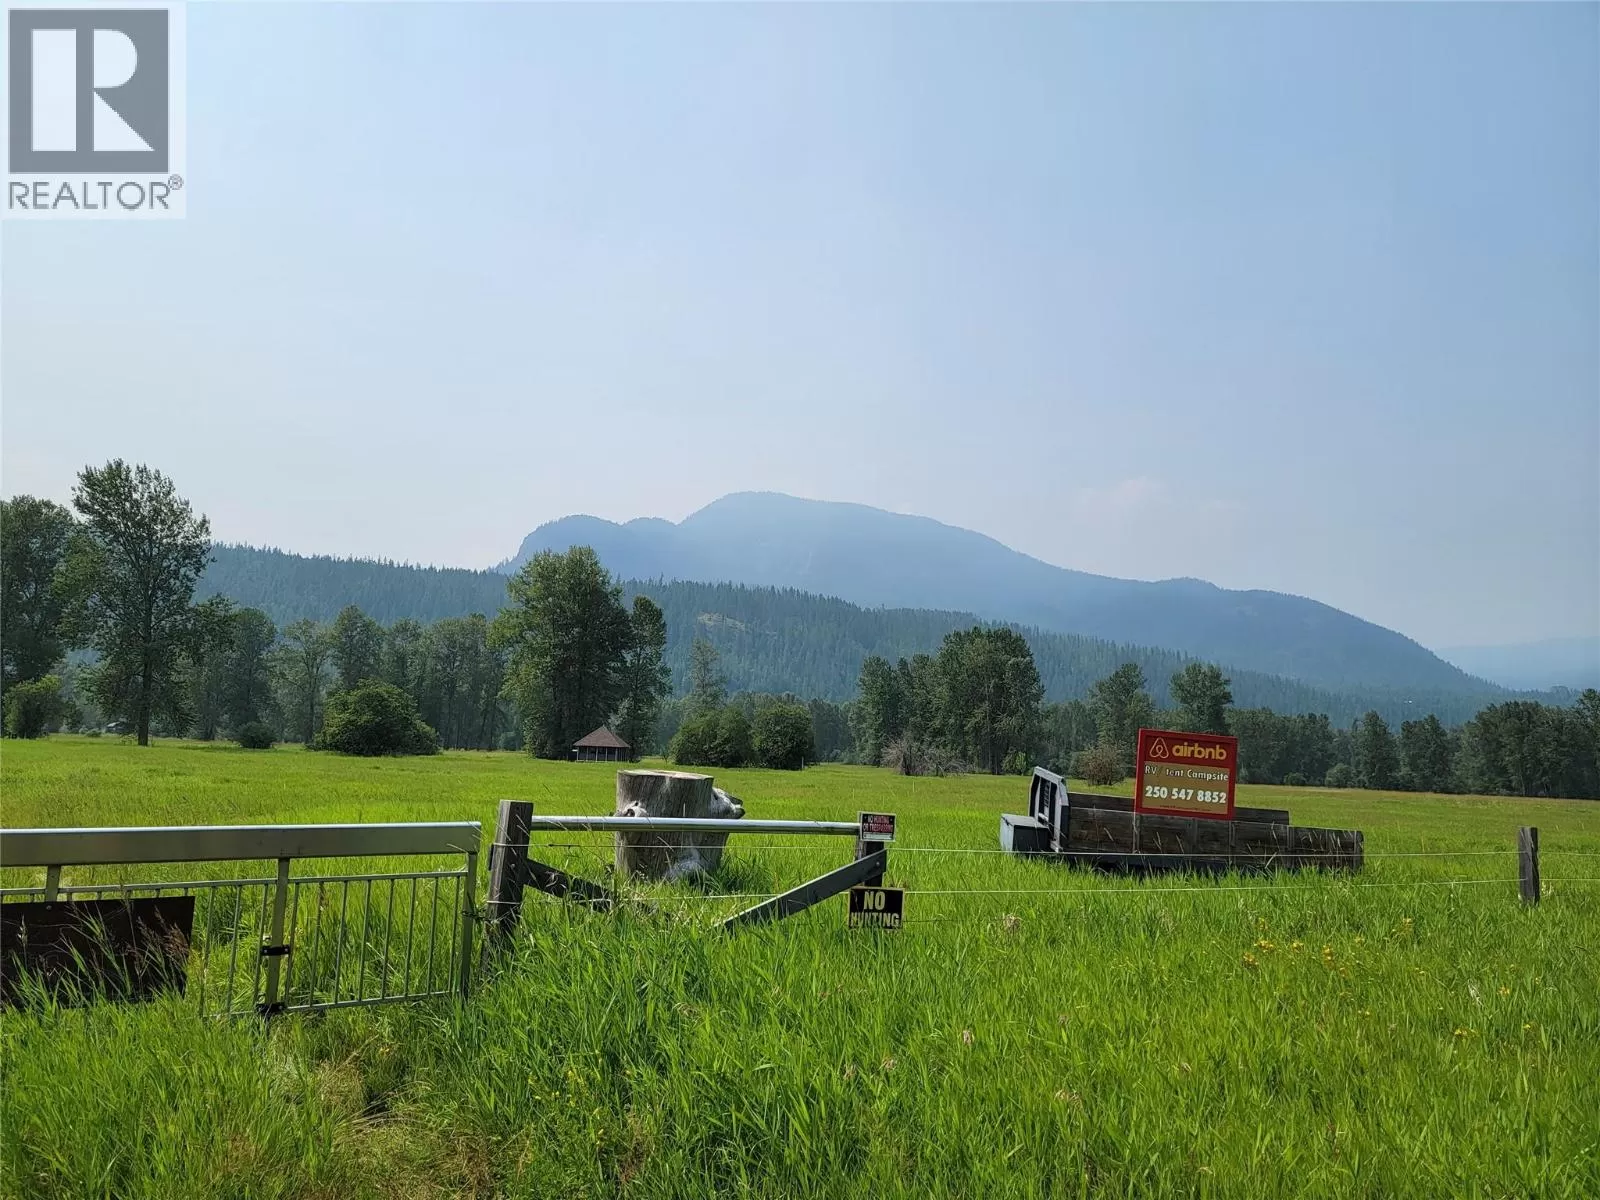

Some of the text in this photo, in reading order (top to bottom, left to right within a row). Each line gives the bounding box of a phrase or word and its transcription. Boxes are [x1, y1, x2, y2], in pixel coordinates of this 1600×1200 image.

[1172, 742, 1227, 760] airbnb
[1145, 765, 1157, 774] RV
[1187, 769, 1229, 781] Campsite
[1145, 785, 1227, 804] 250 547 8852
[863, 891, 886, 910] NO
[850, 912, 900, 927] HUNTING
